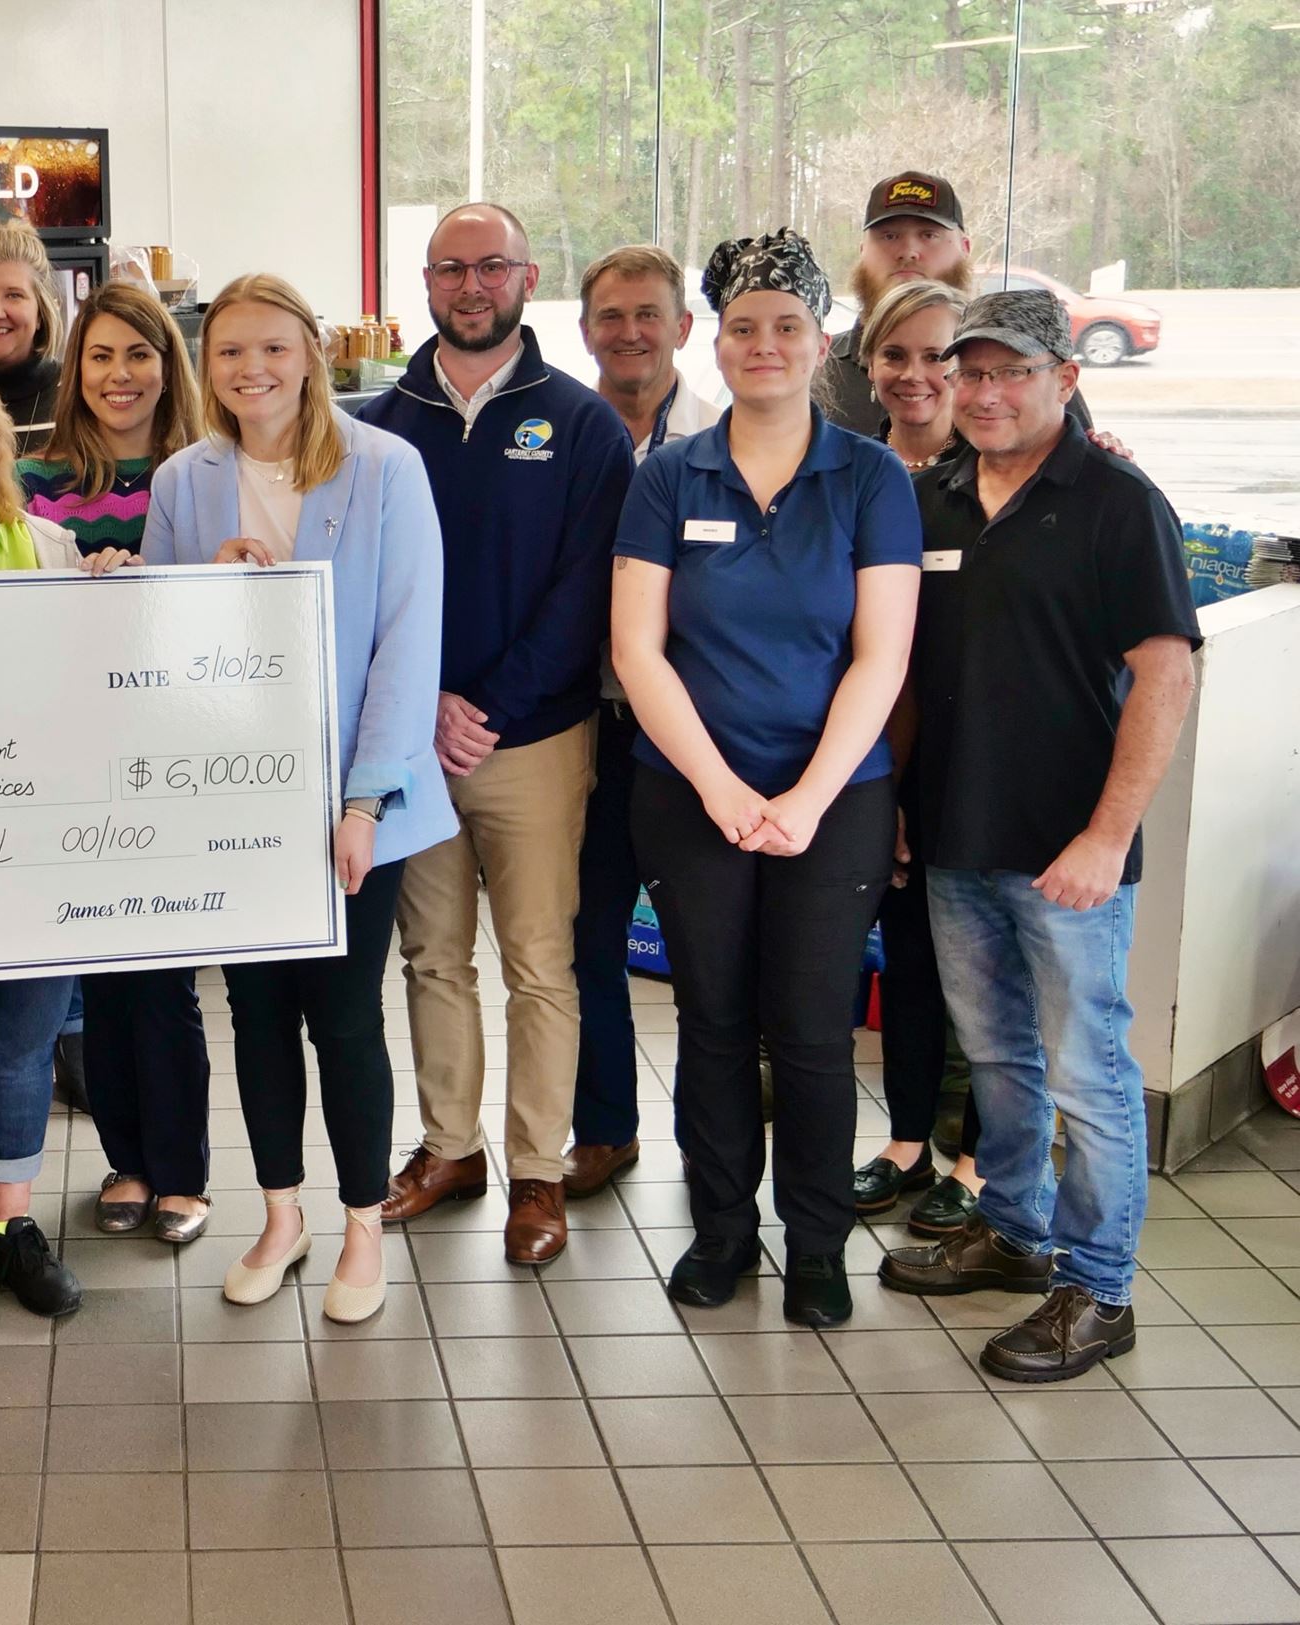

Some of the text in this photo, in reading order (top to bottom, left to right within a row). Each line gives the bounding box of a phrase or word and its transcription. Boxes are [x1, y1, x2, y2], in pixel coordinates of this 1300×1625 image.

[889, 181, 932, 199] Fatty
[186, 645, 285, 682] 3/10/25
[107, 670, 170, 689] DATE
[127, 753, 295, 796] $ 6,100.00
[61, 815, 156, 859] 00/100
[208, 836, 282, 852] DOLLARS
[56, 891, 227, 924] James M. Davis III
[628, 938, 659, 955] epsi
